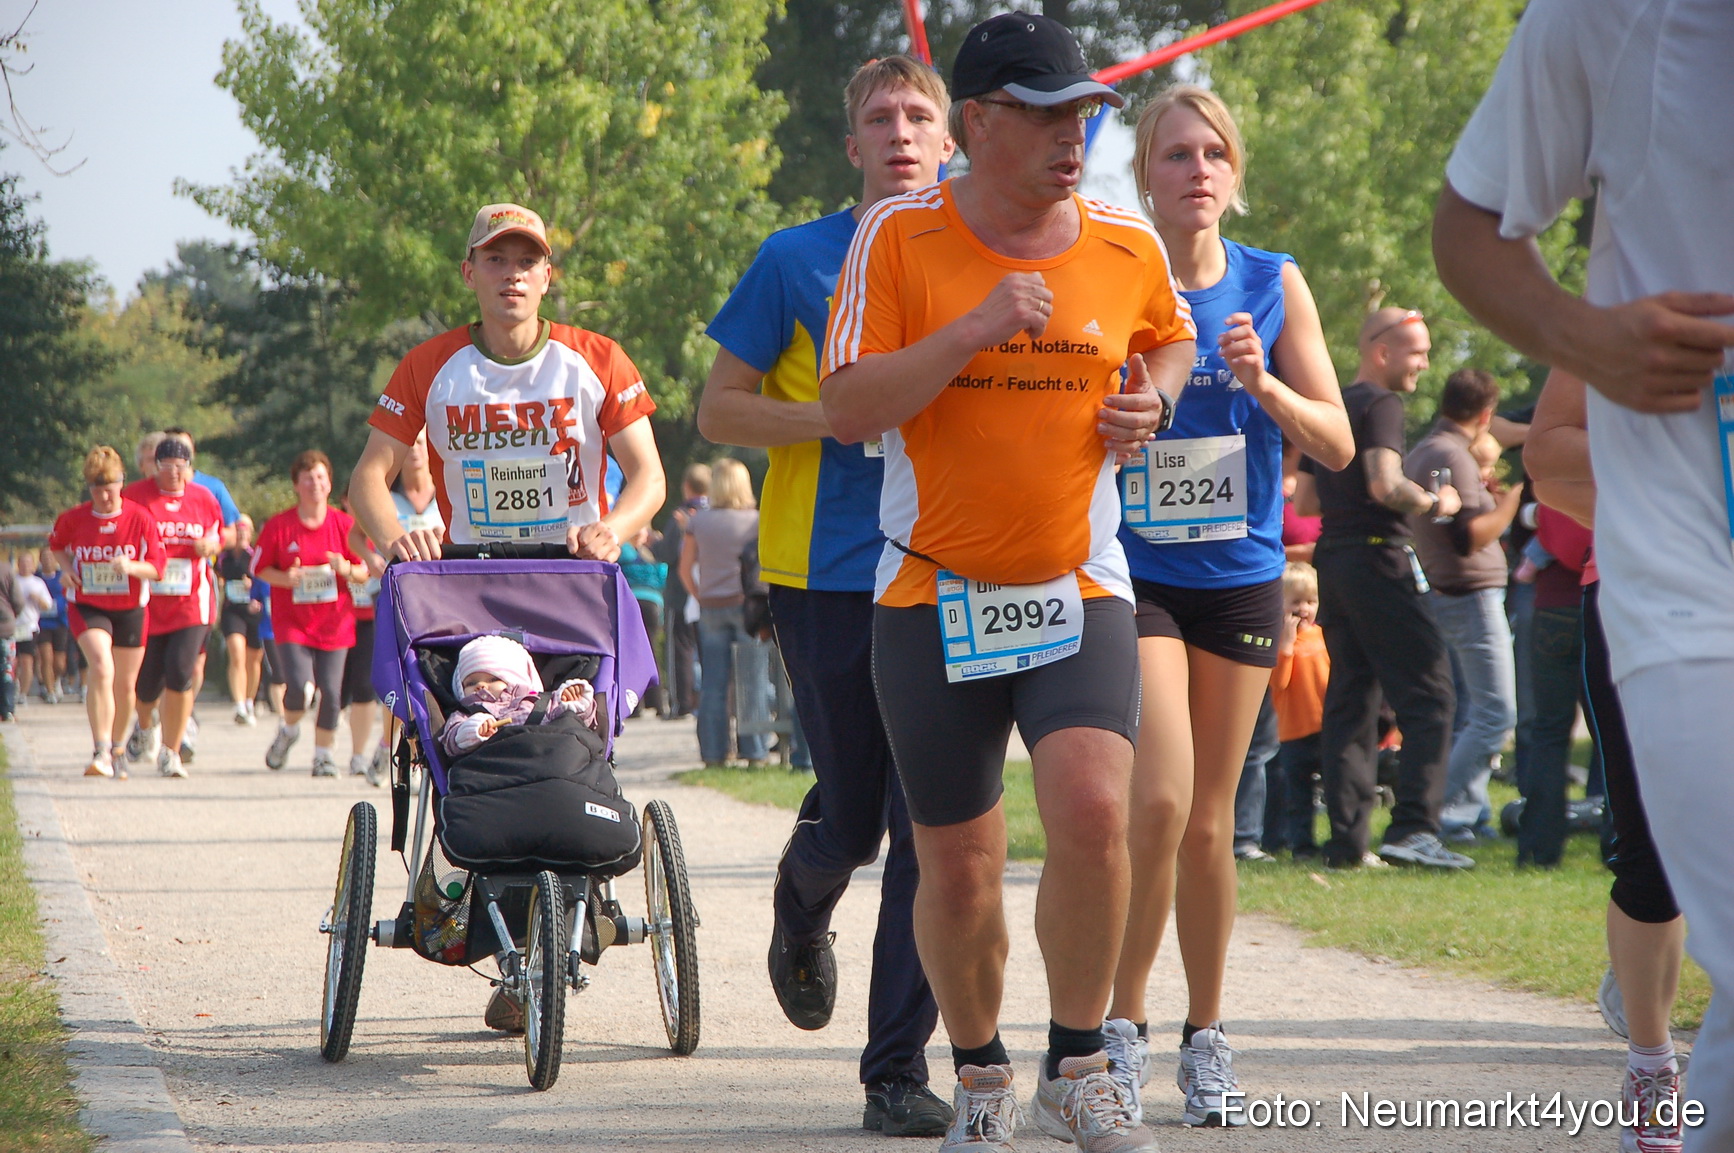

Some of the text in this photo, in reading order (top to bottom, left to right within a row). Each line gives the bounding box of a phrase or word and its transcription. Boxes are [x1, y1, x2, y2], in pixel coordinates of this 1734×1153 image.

[1031, 340, 1099, 355] Notärzte
[1007, 377, 1062, 391] Feucht
[1065, 378, 1089, 392] e.V.
[378, 393, 406, 416] ERZ
[445, 397, 577, 435] MERZ
[447, 422, 550, 451] Reisen
[1156, 451, 1186, 469] Lisa
[491, 463, 547, 481] Reinhard
[1131, 481, 1138, 494] D
[1159, 476, 1234, 506] 2324
[495, 487, 553, 510] 2881
[156, 521, 204, 539] YSCAD
[949, 609, 957, 623] D
[982, 598, 1067, 635] 2992
[1032, 641, 1079, 661] PFLEIDERER
